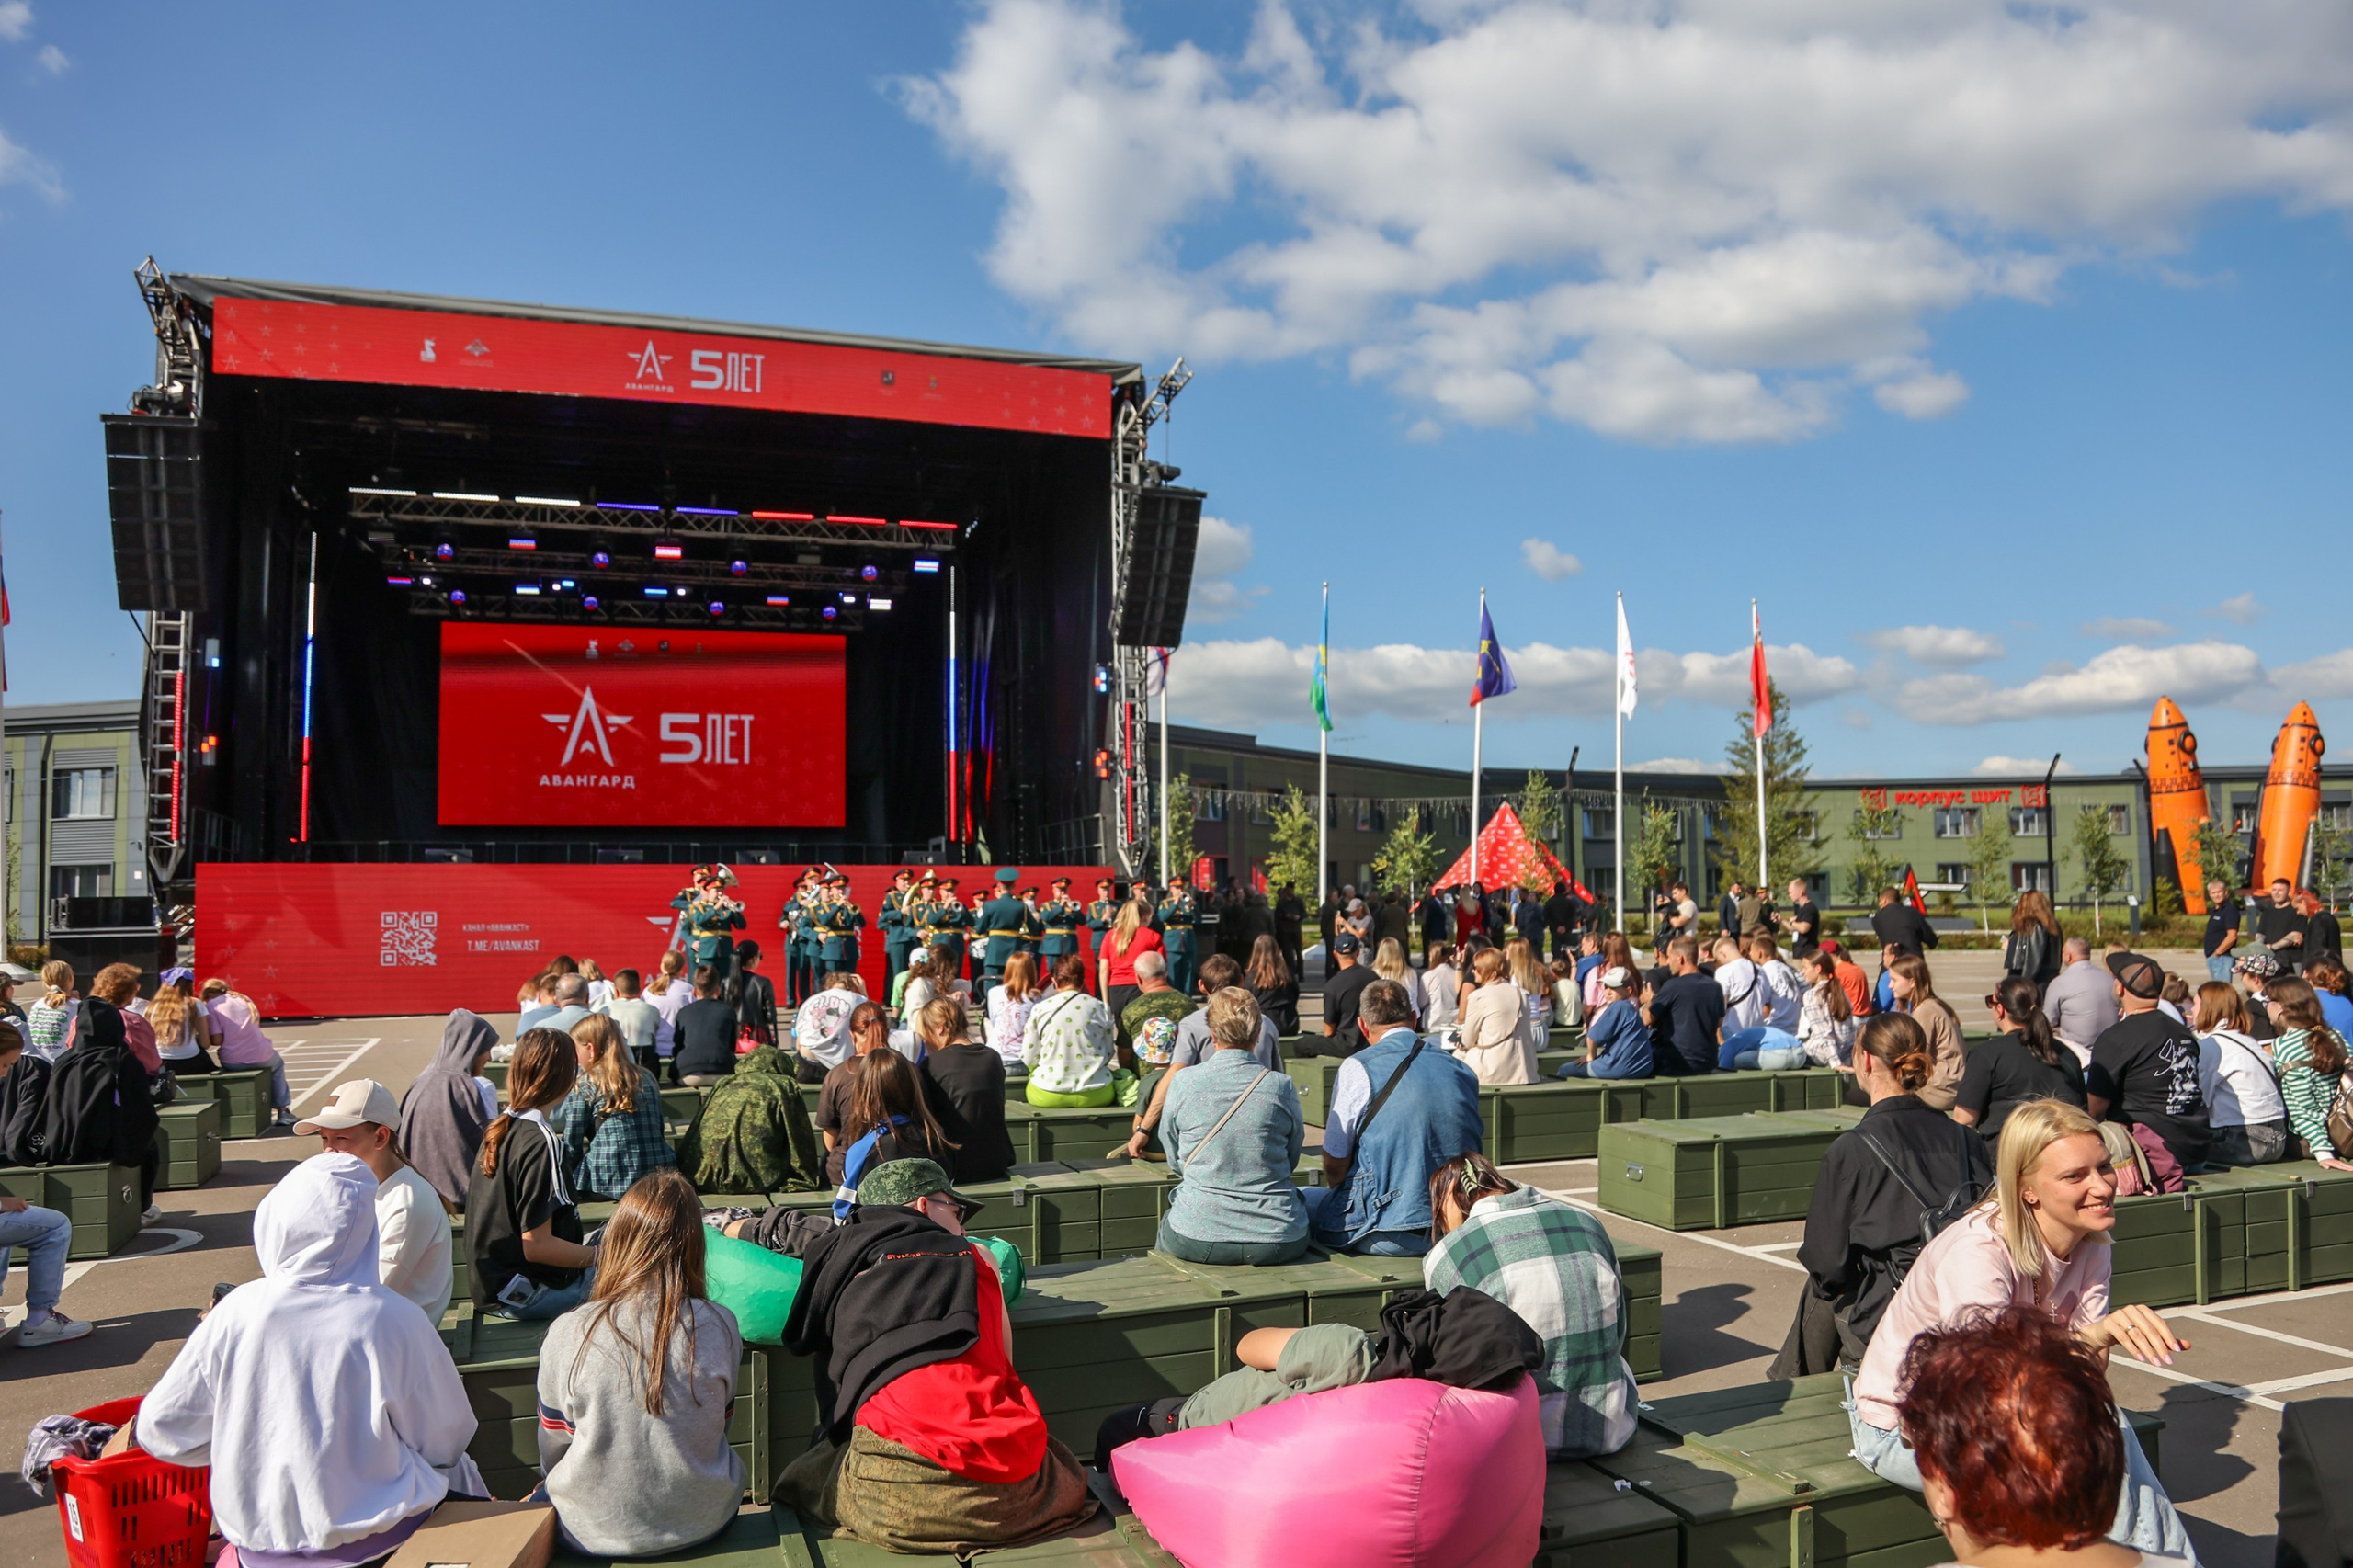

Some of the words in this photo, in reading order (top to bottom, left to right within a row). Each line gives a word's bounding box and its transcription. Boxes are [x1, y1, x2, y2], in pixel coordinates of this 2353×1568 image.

[624, 381, 675, 393] АВАНГАРД
[540, 774, 636, 789] АВАНГАРД
[1894, 790, 1966, 808] корпус
[1971, 789, 2012, 805] щит
[467, 939, 540, 952] T.ME/AVANKAST
[68, 1502, 79, 1526] 15
